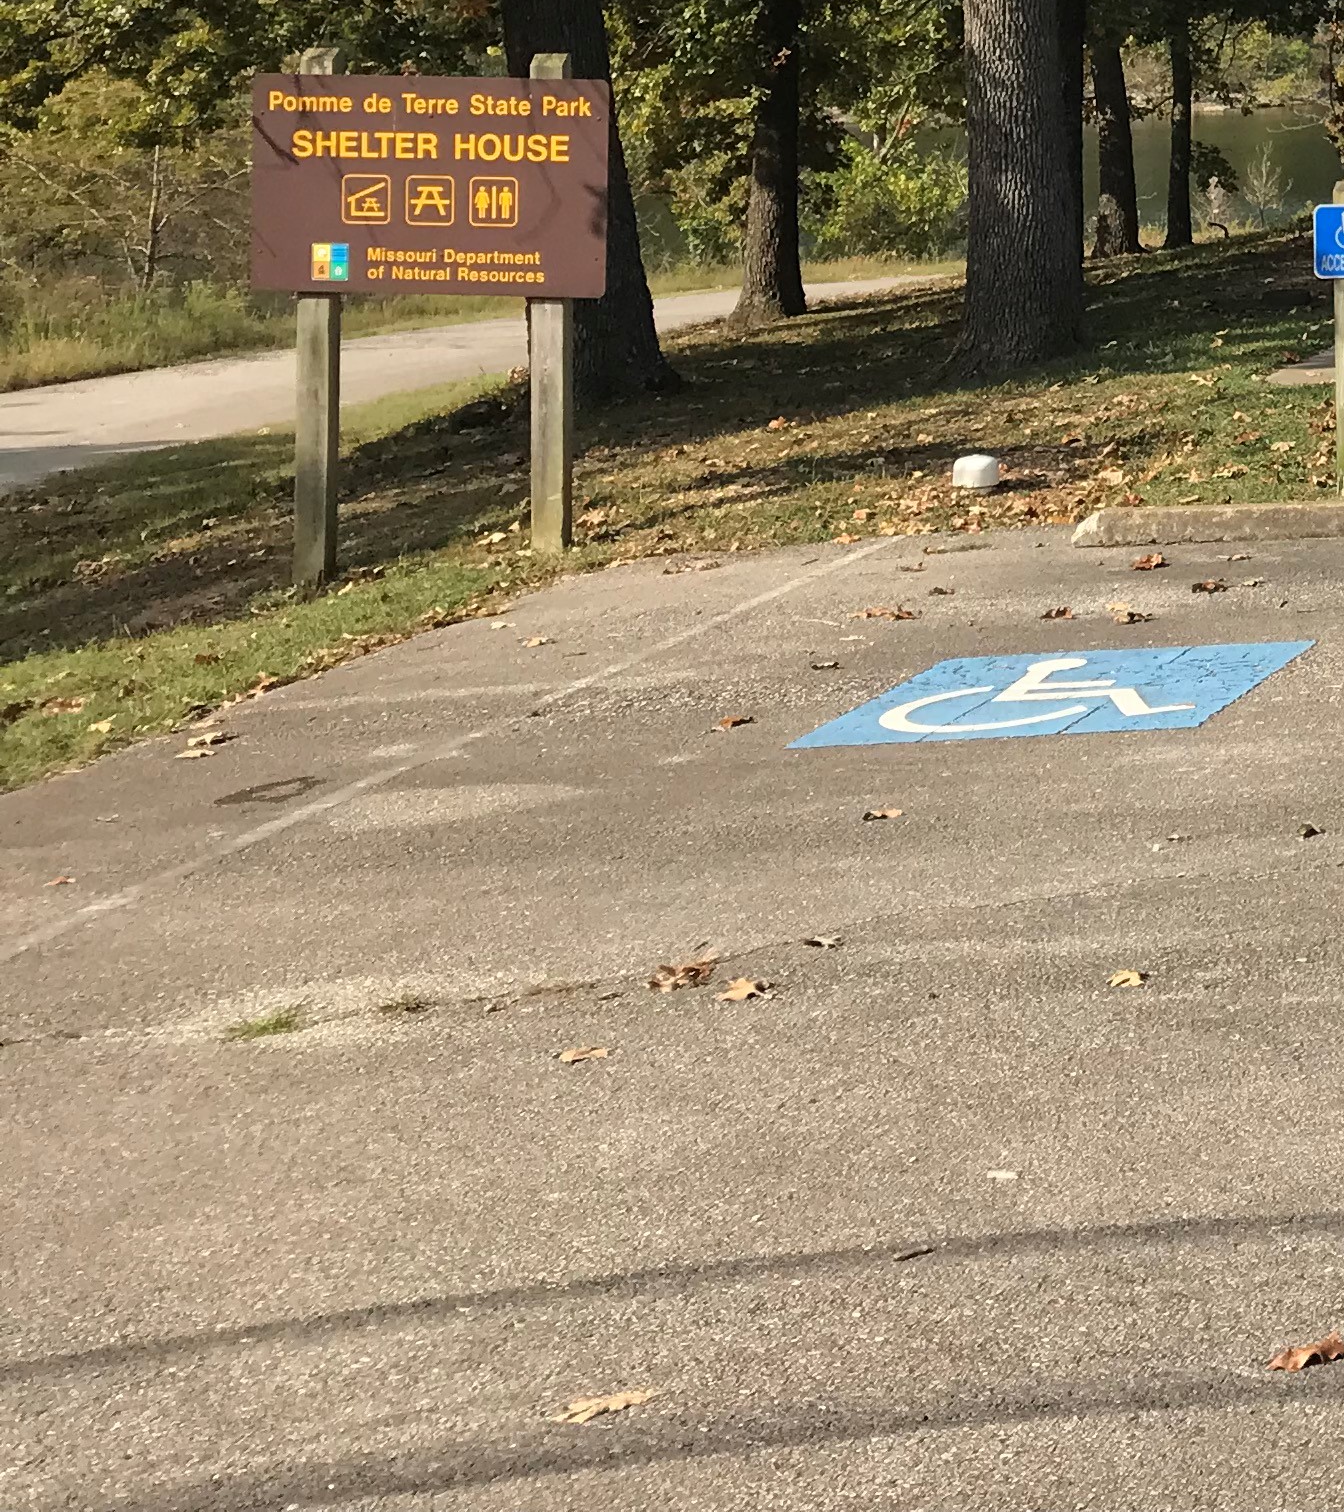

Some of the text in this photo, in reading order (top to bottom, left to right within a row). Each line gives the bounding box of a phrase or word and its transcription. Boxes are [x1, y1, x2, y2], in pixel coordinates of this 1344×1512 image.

[268, 90, 592, 117] Pomme de Terre State Park
[292, 130, 570, 162] SHELTER HOUSE
[367, 247, 540, 267] Missouri Department
[367, 266, 545, 284] of Natural Resources
